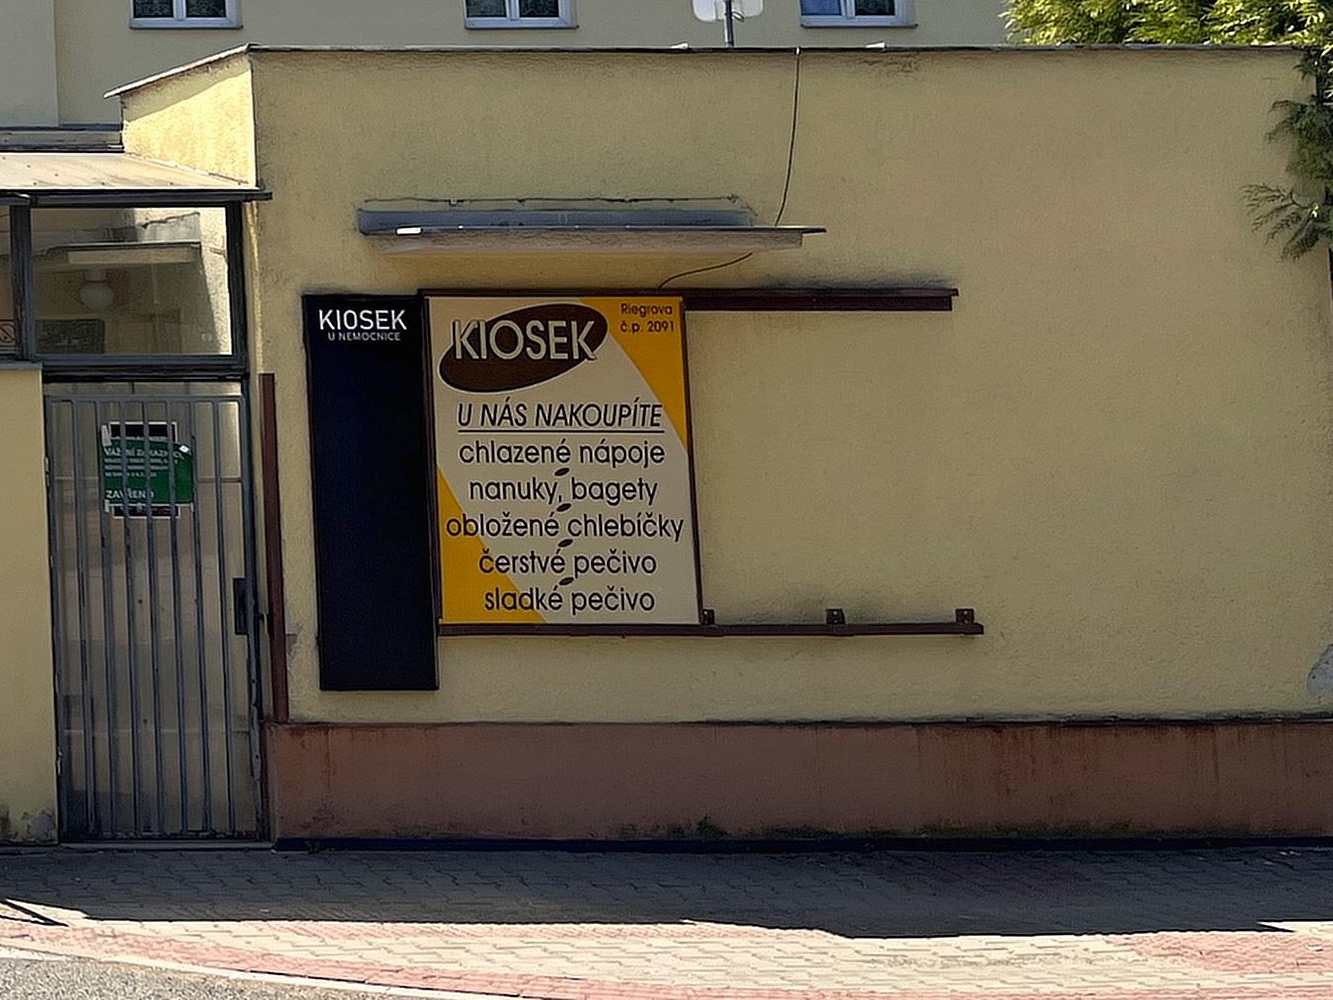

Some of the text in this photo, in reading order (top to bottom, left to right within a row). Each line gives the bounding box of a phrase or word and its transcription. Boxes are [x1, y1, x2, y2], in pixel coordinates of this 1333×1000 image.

[319, 309, 407, 330] KIOSEK
[621, 303, 673, 318] Riegrova
[327, 332, 401, 341] U NEMOCNICE
[452, 318, 596, 361] KIOSEK
[620, 320, 675, 334] č.p. 2091
[458, 397, 663, 428] U NÁS NAKOUPÍTE
[459, 439, 665, 468] chlazené nápoje
[469, 477, 658, 505] nanuky, bagety
[446, 513, 684, 542] obložené chlebíčky
[479, 549, 656, 579] čerstvé pečivo
[484, 586, 655, 615] sladké pečivo
